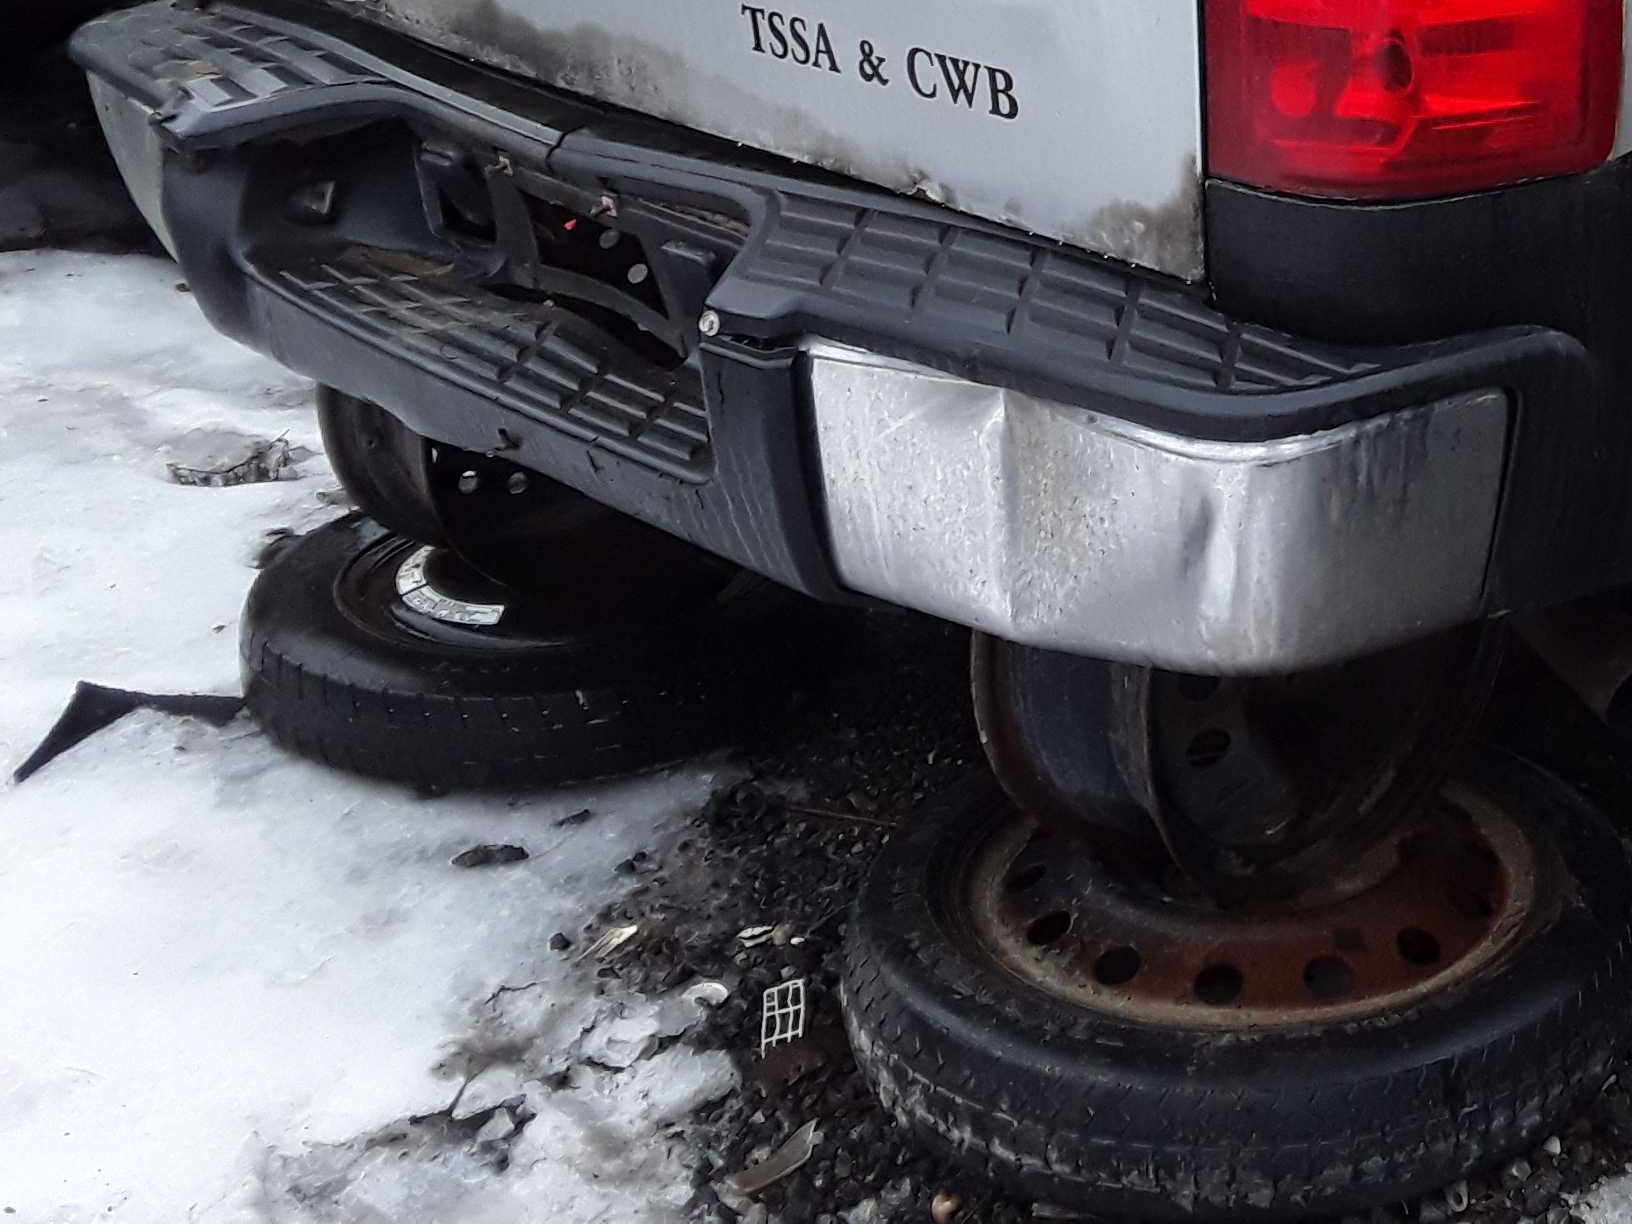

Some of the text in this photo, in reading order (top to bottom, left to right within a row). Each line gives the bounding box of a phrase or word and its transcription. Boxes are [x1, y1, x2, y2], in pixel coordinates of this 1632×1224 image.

[740, 4, 1020, 120] TSSA & CWB
